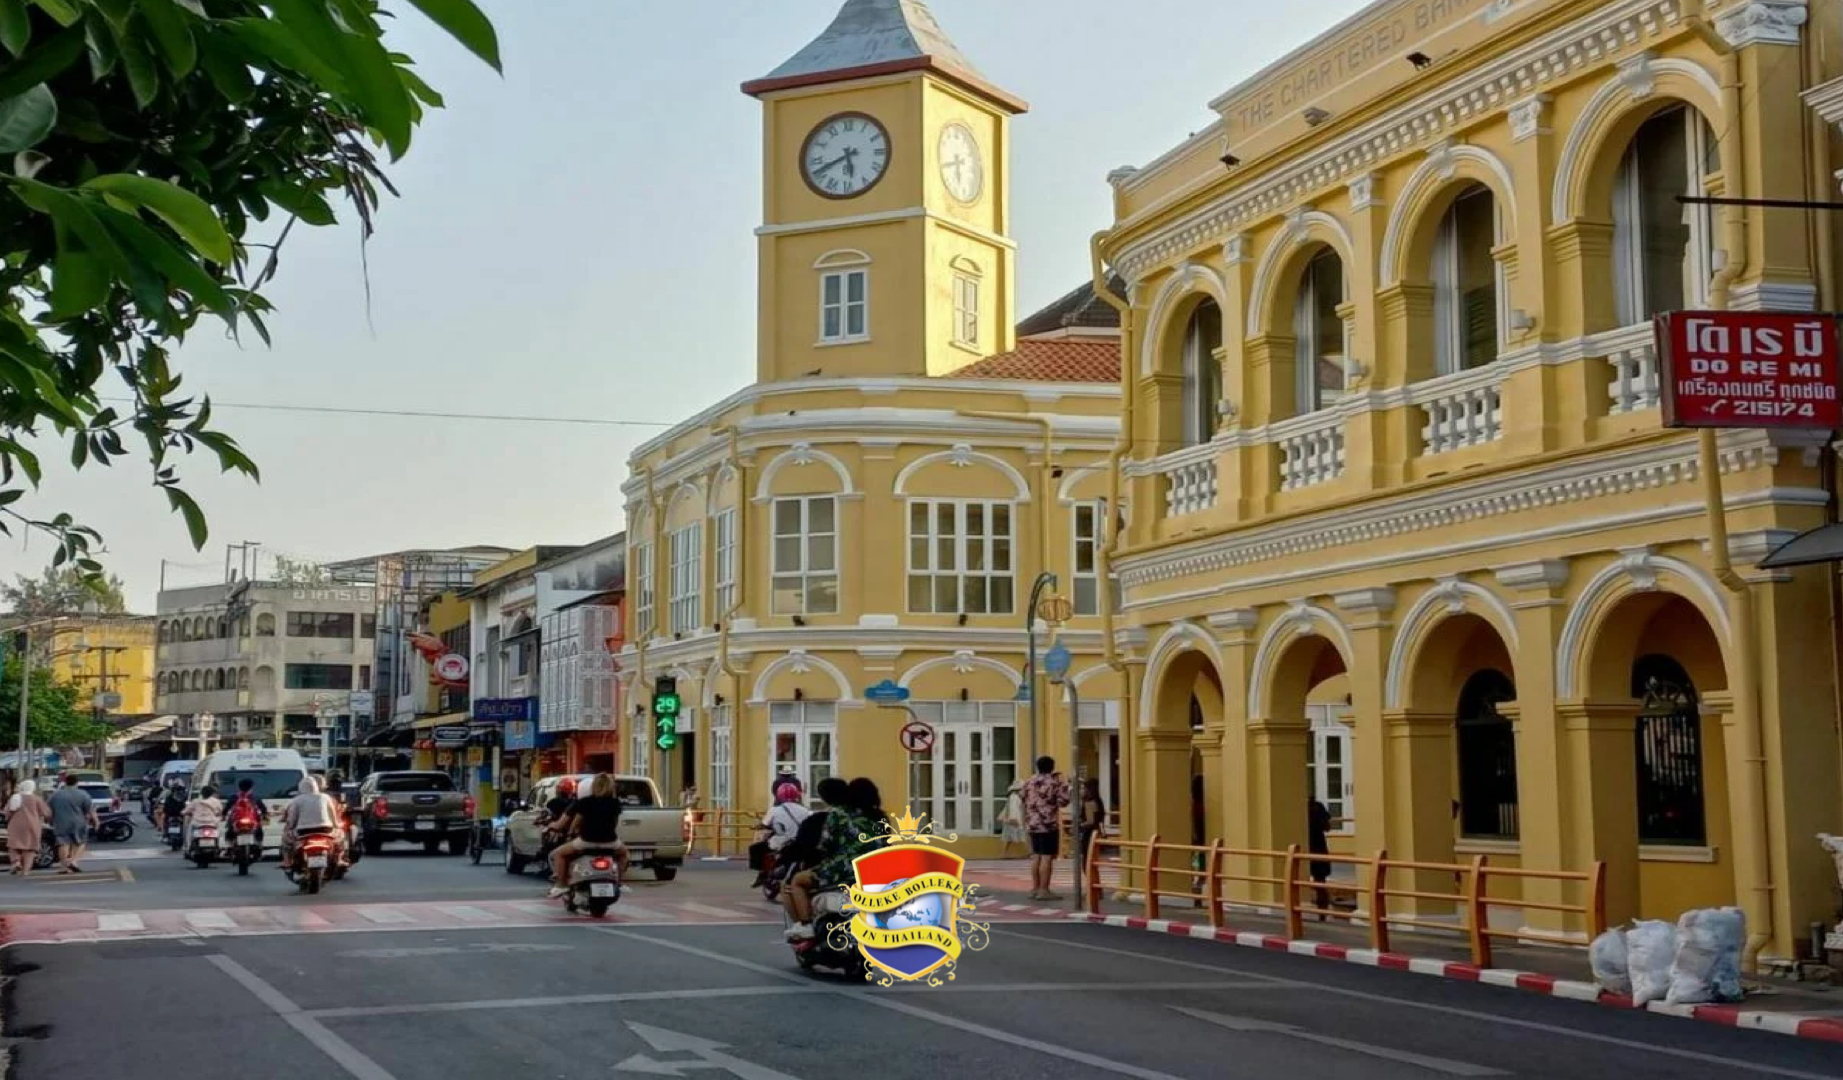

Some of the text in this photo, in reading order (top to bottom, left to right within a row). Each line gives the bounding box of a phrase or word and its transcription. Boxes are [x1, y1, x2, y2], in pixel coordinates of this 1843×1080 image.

[1238, 0, 1469, 132] THE CHARTERED BAN
[1686, 318, 1823, 357] โด เร มี
[1691, 358, 1822, 378] DO RE MI
[1733, 401, 1816, 417] 215174
[656, 697, 676, 713] 29
